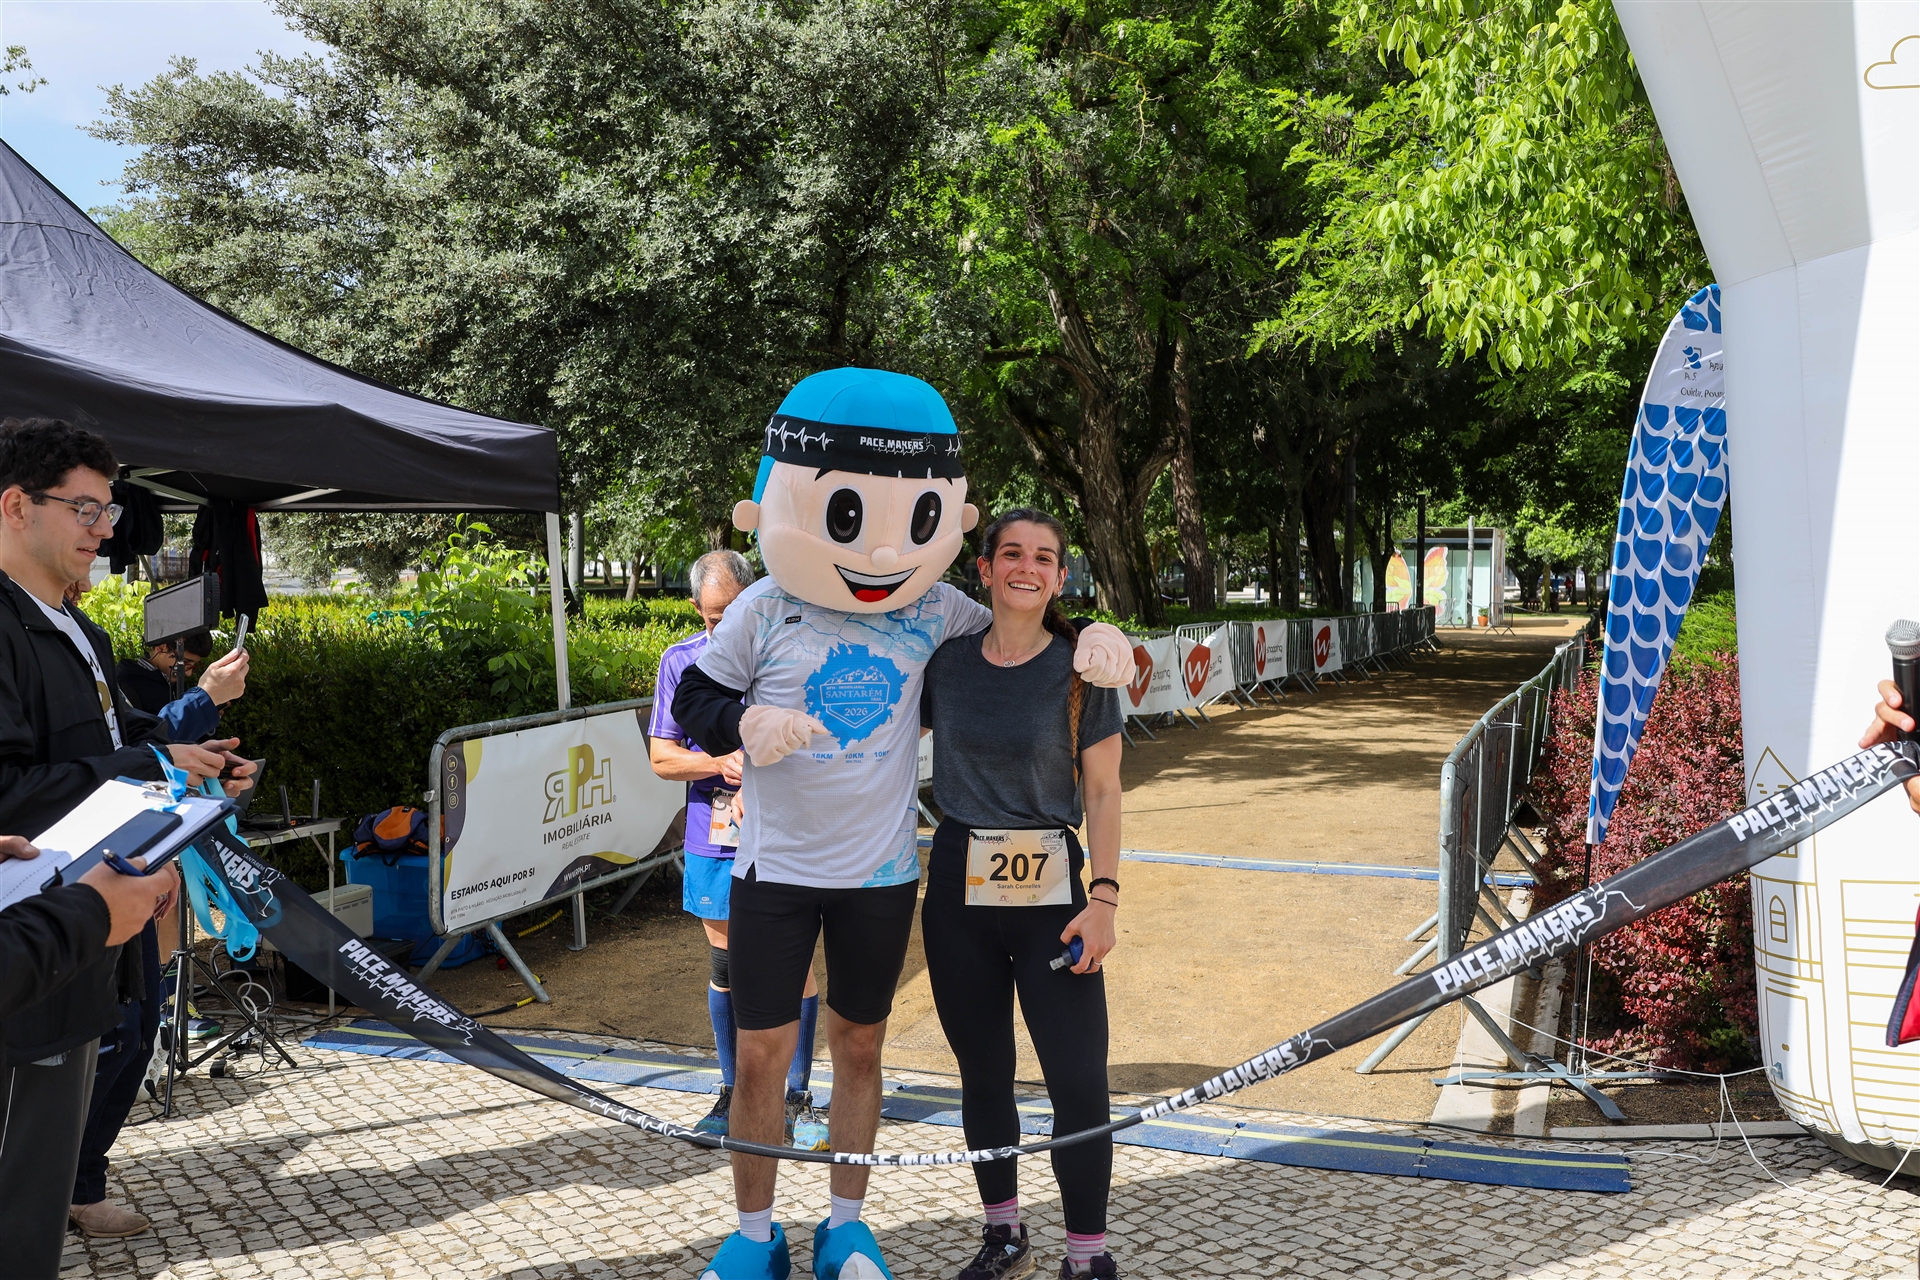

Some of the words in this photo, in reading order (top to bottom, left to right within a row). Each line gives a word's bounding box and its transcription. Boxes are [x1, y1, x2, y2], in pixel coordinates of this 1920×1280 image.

[887, 439, 924, 451] MAKERS
[1187, 659, 1209, 683] W
[825, 688, 883, 699] SANTARÉM
[844, 708, 868, 717] 2026
[811, 752, 833, 760] 18KM
[845, 752, 864, 760] 10KM
[1727, 793, 1795, 842] PACE
[1792, 743, 1896, 810] MAKERS
[543, 812, 613, 845] IMOBILIÁRIA
[989, 852, 1049, 881] 207
[451, 880, 489, 900] ESTAMOS
[490, 875, 511, 889] AQUI
[512, 870, 528, 882] POR
[528, 867, 535, 877] SI
[1432, 946, 1498, 995] PACE
[1495, 895, 1595, 964] MAKERS
[338, 938, 391, 977] PACE
[381, 972, 459, 1025] MAKERS
[1203, 1042, 1298, 1099] MAKERS
